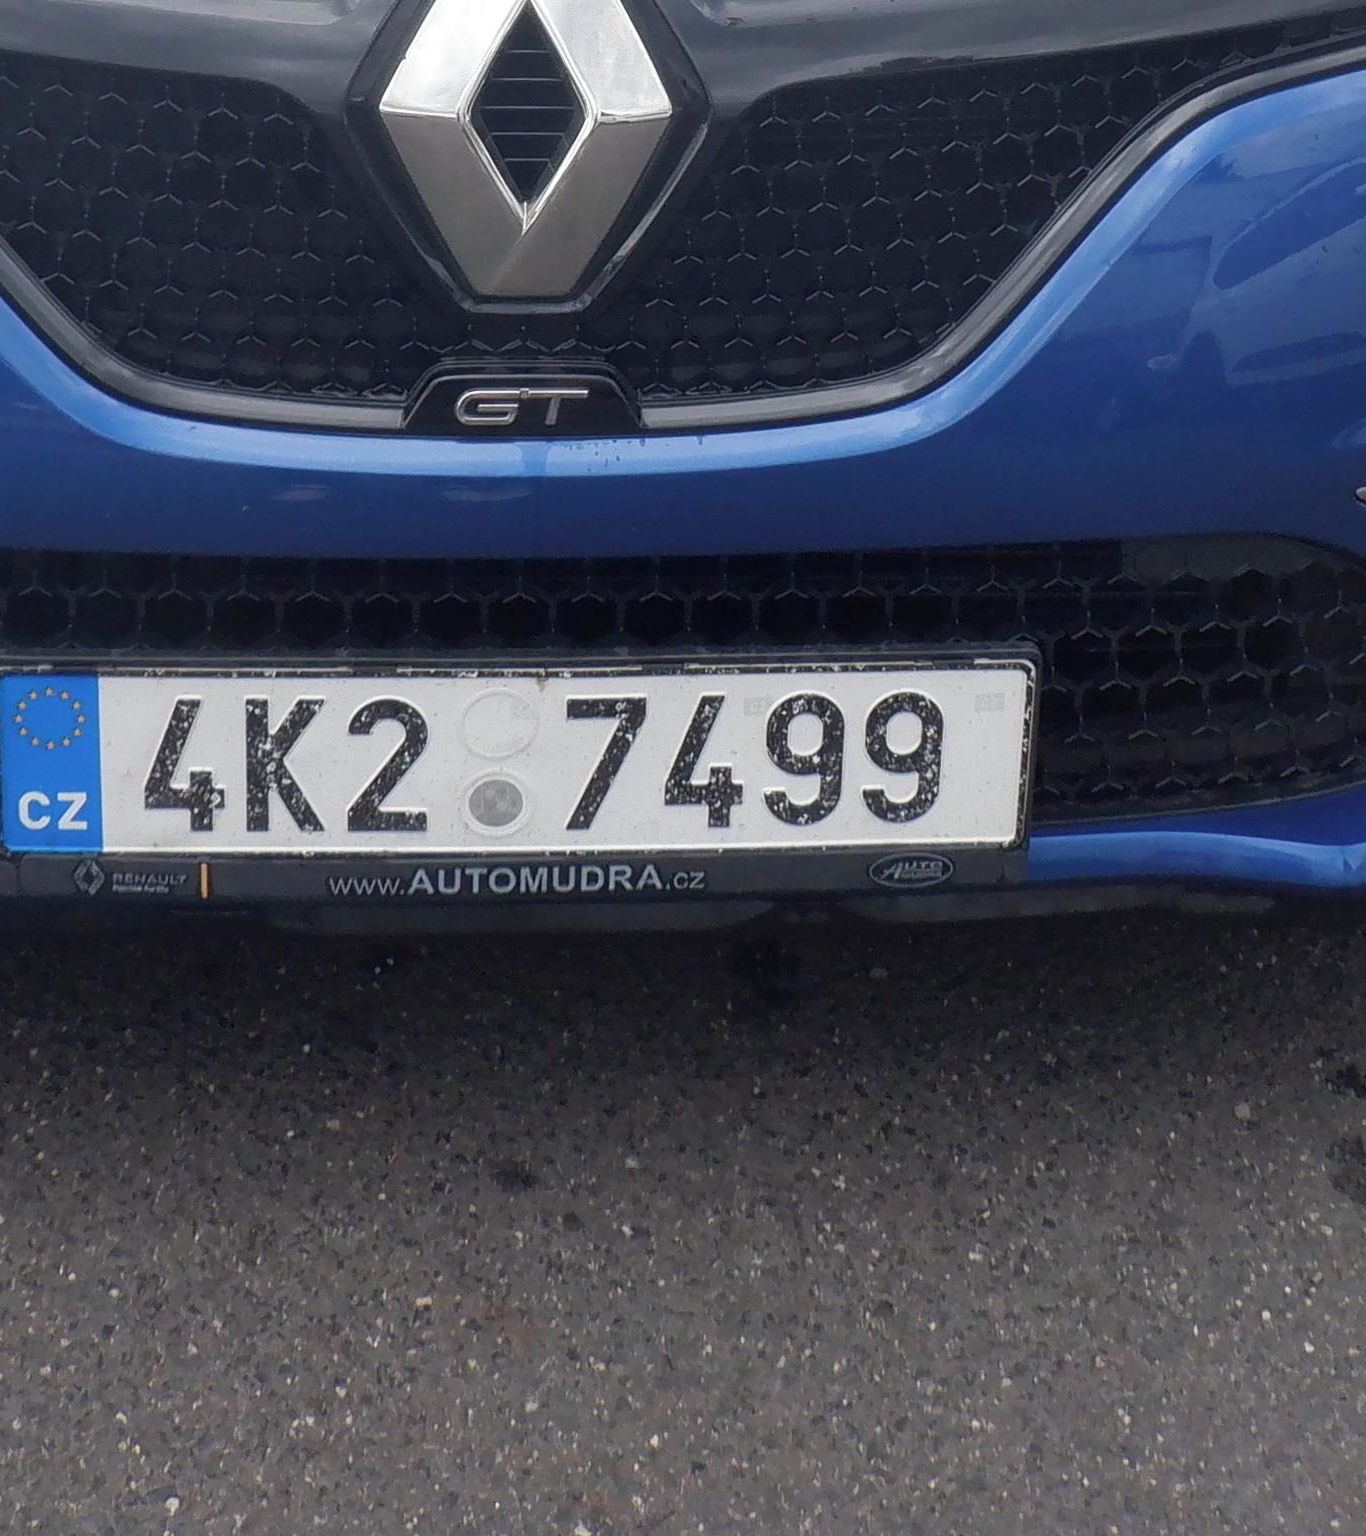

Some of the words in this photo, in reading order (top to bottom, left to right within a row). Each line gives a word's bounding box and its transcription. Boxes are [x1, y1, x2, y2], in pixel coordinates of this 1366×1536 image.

[454, 387, 589, 426] GT
[144, 693, 430, 833] 4K2
[565, 690, 945, 827] 7499
[17, 791, 88, 831] CZ
[112, 872, 187, 885] RENAULT
